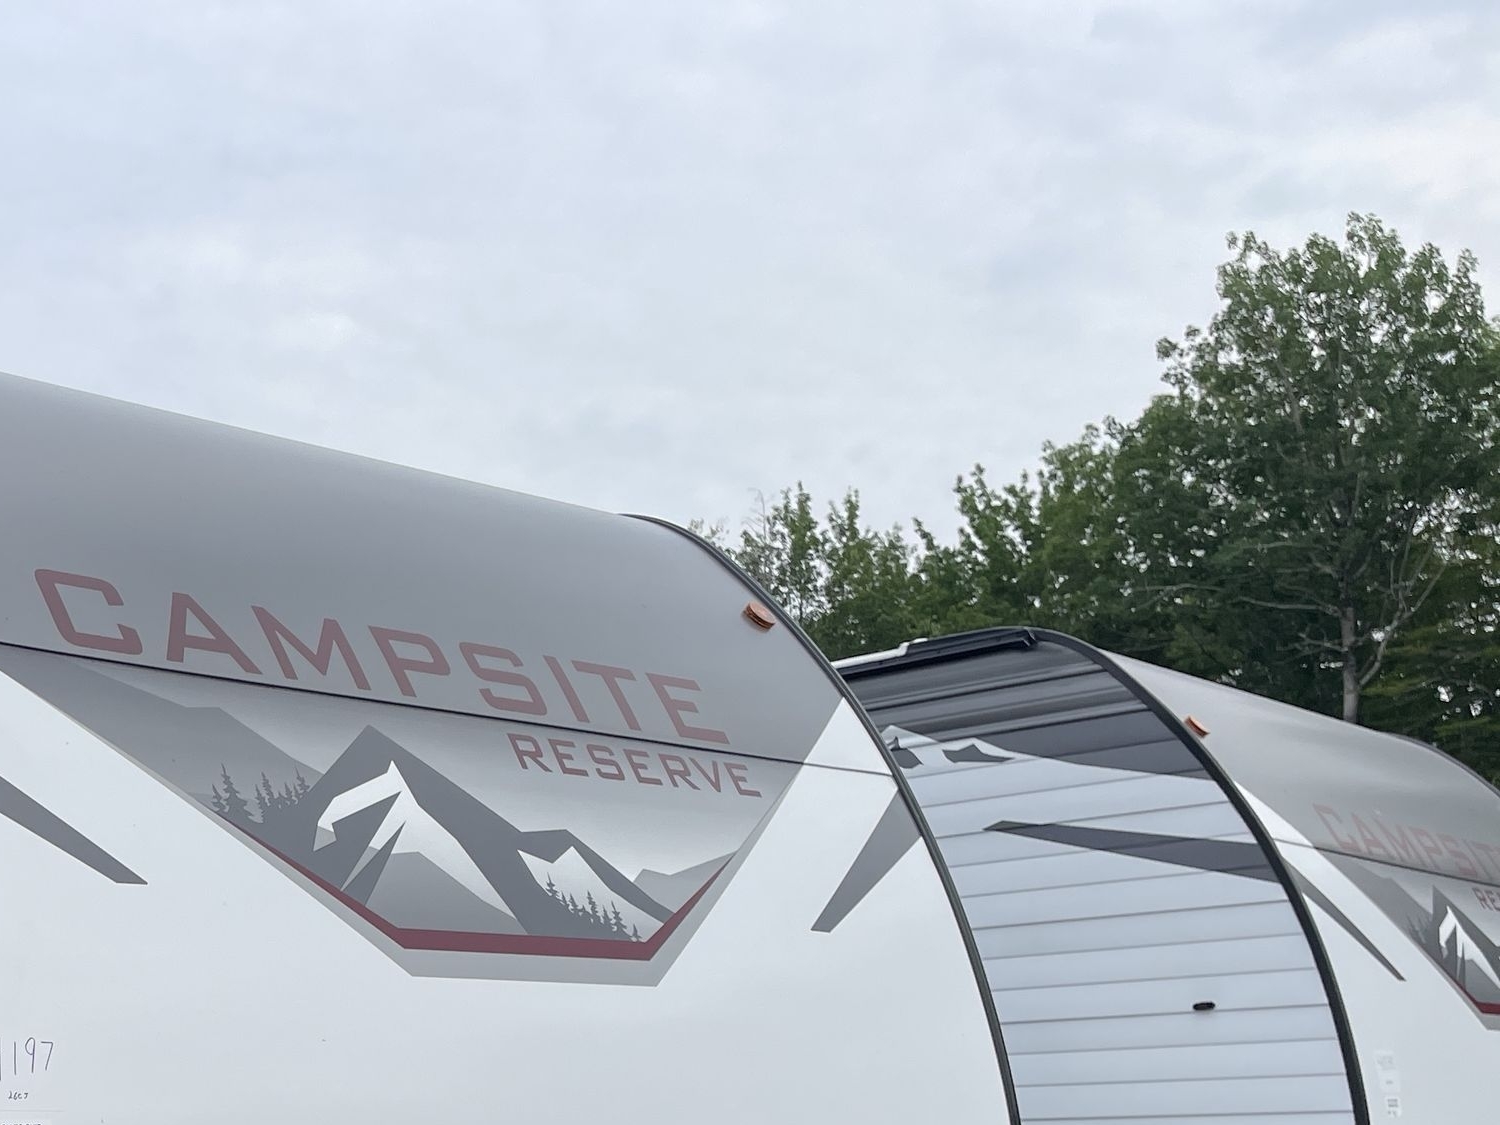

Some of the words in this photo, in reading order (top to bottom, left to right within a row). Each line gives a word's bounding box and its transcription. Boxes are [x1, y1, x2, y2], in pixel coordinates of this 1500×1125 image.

[34, 568, 731, 744] CAMPSITE
[506, 732, 762, 798] RESERVE
[1312, 803, 1500, 882] CAMPSIT
